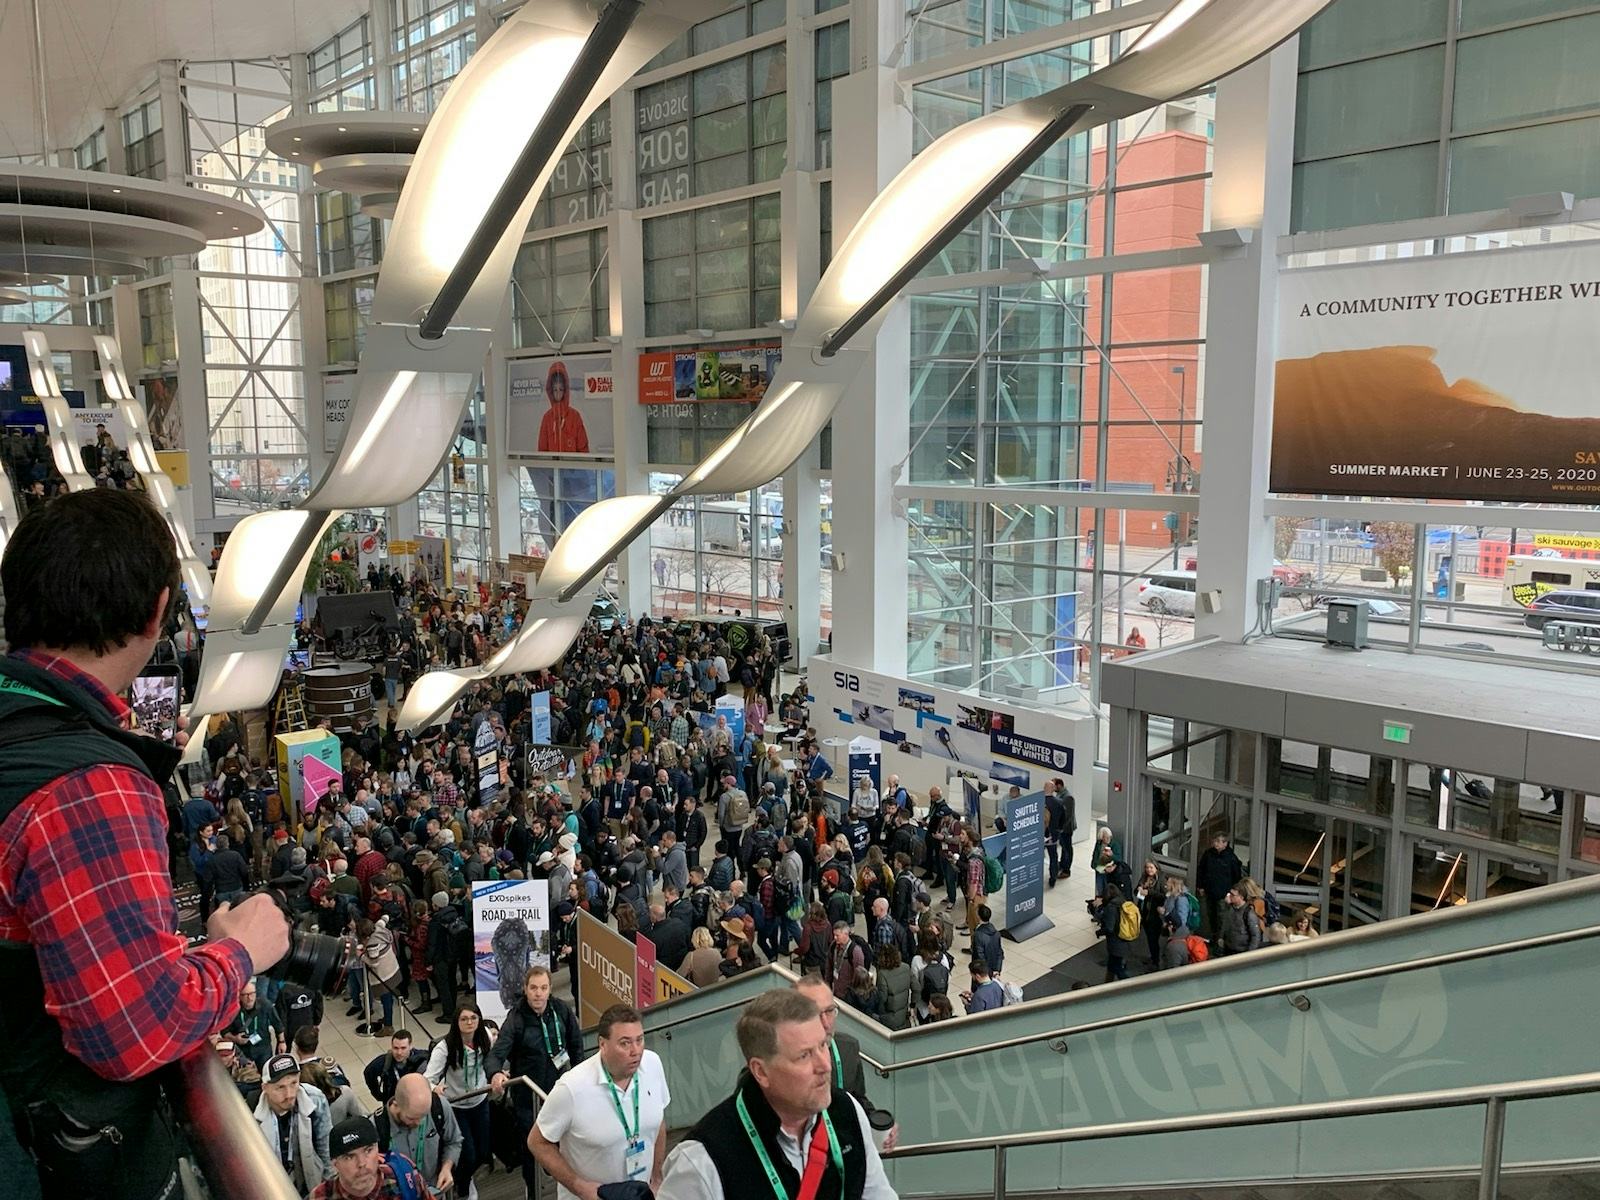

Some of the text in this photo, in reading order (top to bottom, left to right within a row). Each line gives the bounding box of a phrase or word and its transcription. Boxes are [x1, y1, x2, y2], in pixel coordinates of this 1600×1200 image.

[1300, 303, 1312, 317] A
[1316, 293, 1440, 316] COMMUNITY
[1445, 284, 1563, 308] TOGETHER
[326, 399, 338, 410] MAY
[1329, 464, 1597, 481] SUMMER MARKET JUNE 23-25, 2020
[1537, 536, 1593, 548] ski sauvage
[996, 734, 1052, 756] WE ARE UNITED
[528, 747, 561, 764] Outdoor
[868, 753, 878, 766] 1
[1011, 746, 1053, 764] BY WINTER.
[1014, 802, 1038, 819] SHUTTLE
[1012, 813, 1040, 831] SCHEDULE
[488, 894, 532, 903] EXOspikes
[481, 909, 507, 921] ROAD
[516, 908, 542, 921] TRAIL
[581, 941, 633, 999] OUTDOOR
[602, 978, 633, 1007] RETAILER
